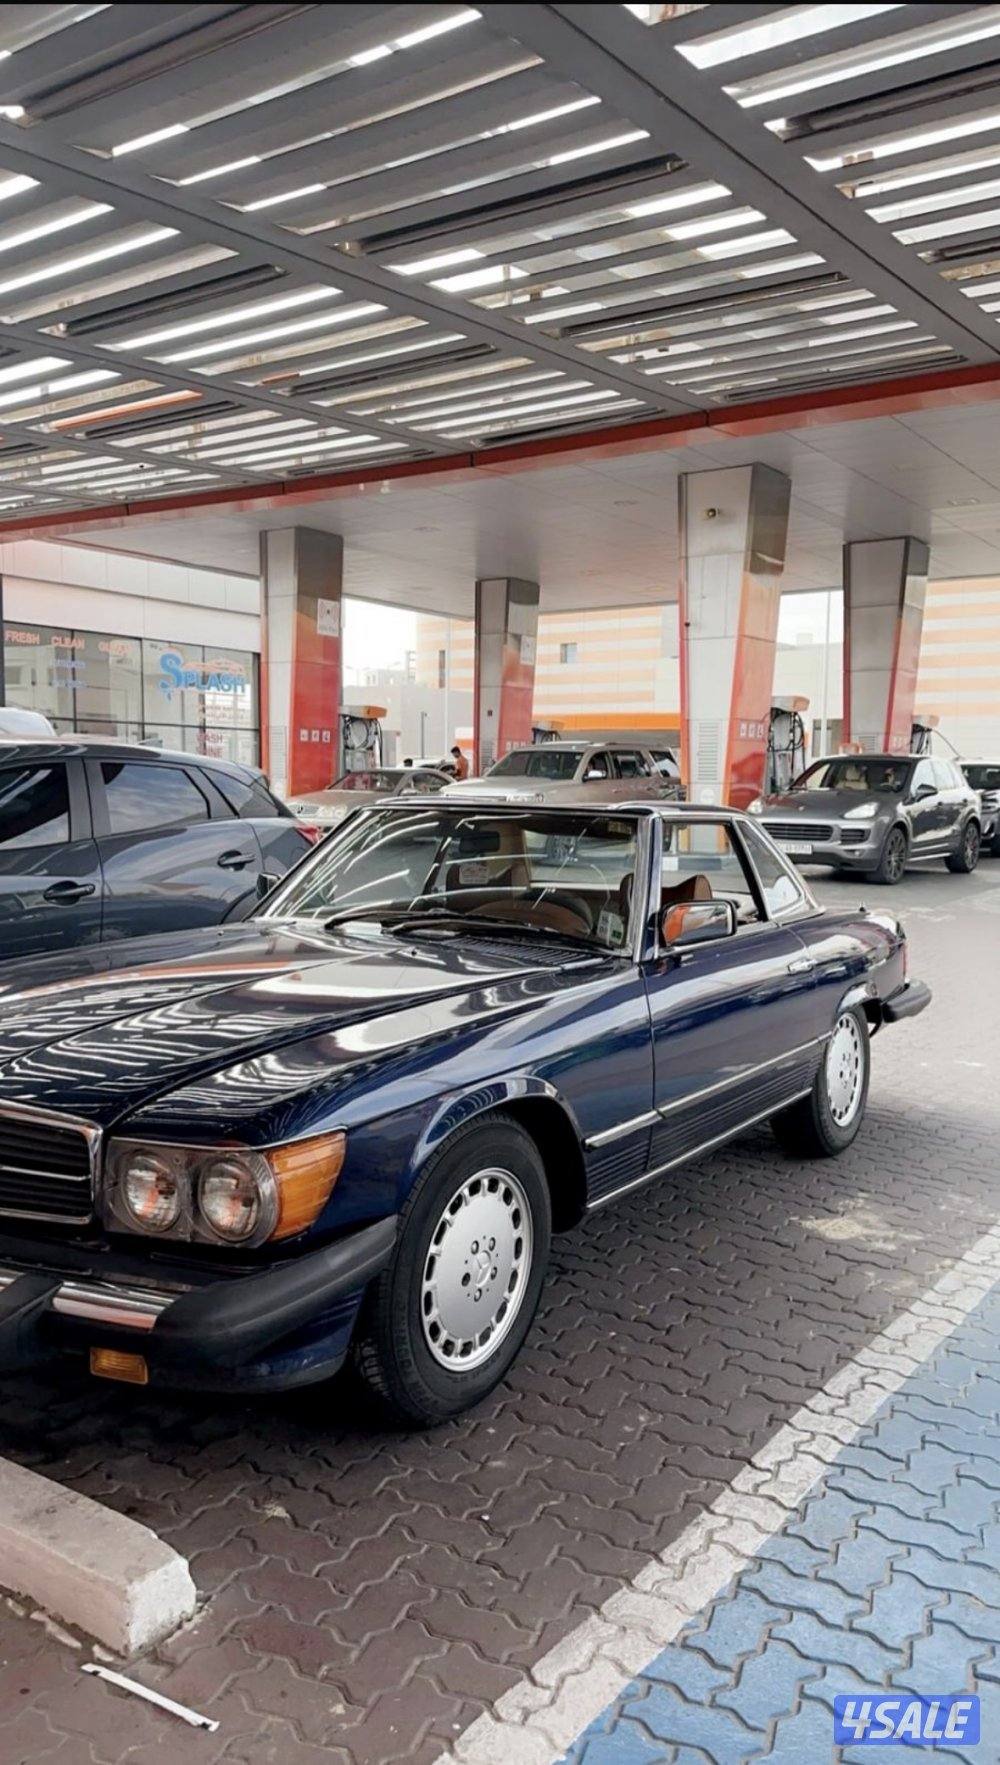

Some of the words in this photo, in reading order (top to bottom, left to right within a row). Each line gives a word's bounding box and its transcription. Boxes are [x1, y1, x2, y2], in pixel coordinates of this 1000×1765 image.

[5, 630, 40, 645] FRESH
[51, 636, 85, 650] CLEAN
[159, 652, 246, 692] SPLASH
